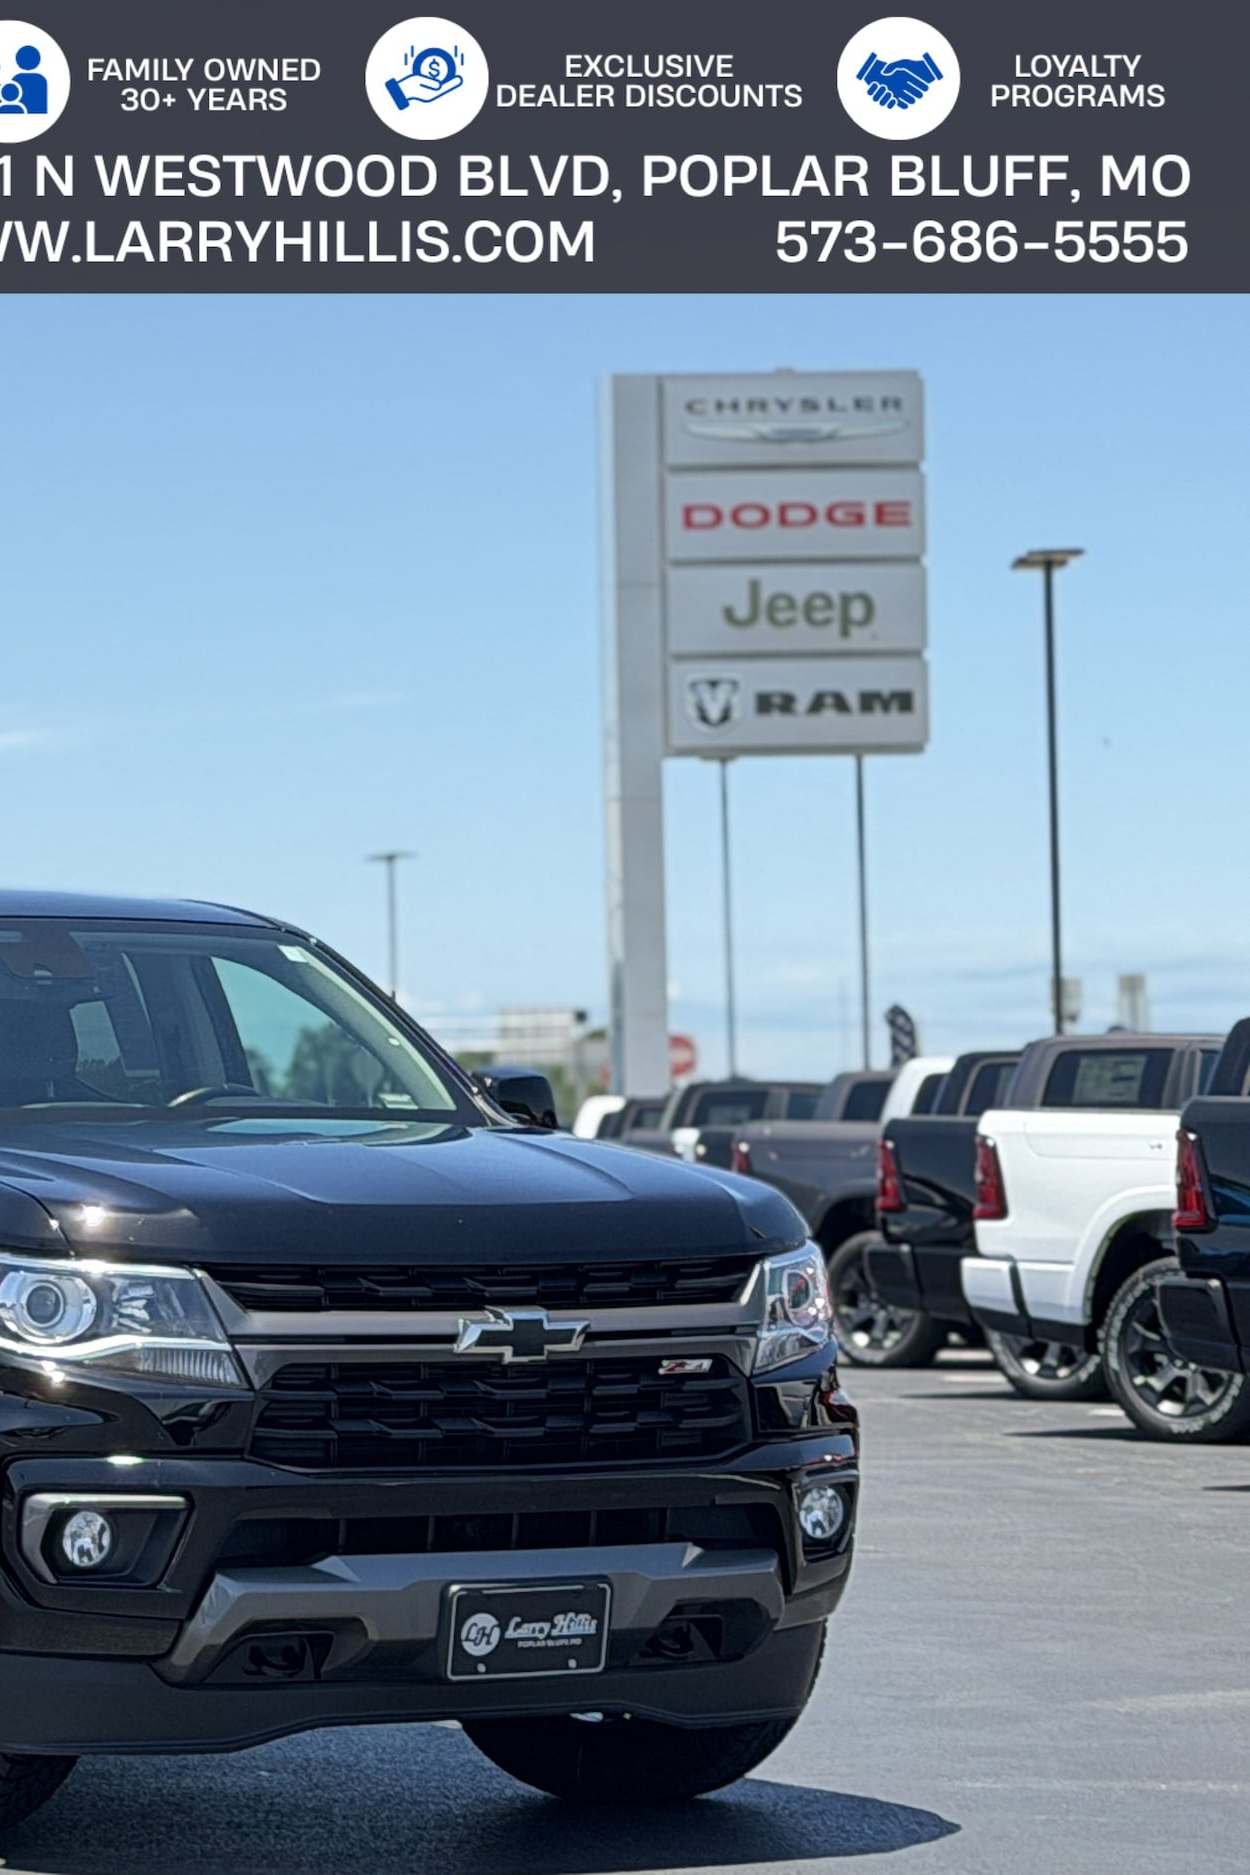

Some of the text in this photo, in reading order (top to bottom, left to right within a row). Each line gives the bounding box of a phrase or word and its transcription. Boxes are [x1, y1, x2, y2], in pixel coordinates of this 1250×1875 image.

[684, 396, 903, 417] CHRYSLER
[683, 501, 912, 531] DODGE
[723, 578, 876, 638] Jeep
[755, 690, 914, 716] RAM
